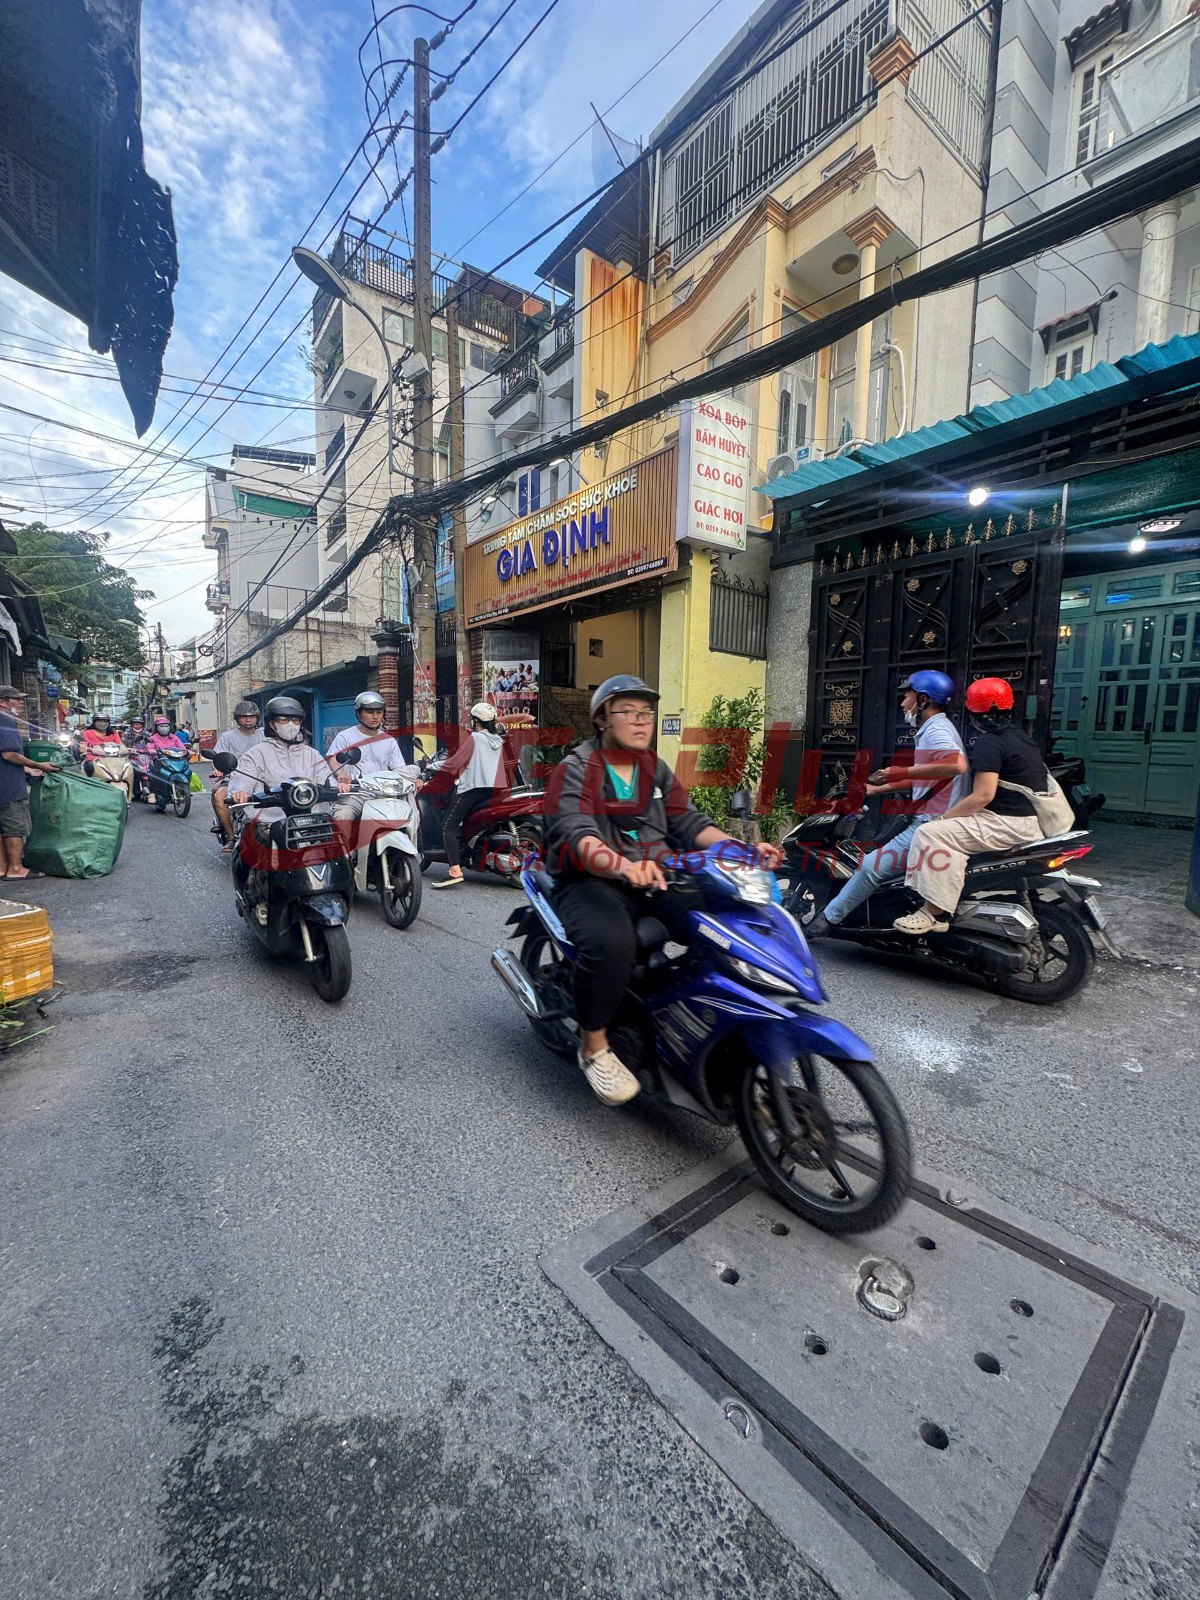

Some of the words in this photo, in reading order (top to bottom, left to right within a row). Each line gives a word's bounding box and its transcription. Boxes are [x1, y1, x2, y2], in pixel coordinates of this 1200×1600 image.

[698, 401, 723, 422] XOA
[725, 412, 747, 430] BÓP
[695, 428, 717, 448] BẤM
[719, 437, 746, 459] HUYỆT
[696, 462, 721, 481] CẠO
[723, 470, 743, 489] GIÓ
[482, 536, 506, 555] TRUNG
[508, 528, 525, 544] TÂM
[527, 512, 555, 535] CHĂM
[556, 500, 578, 522] SÓC
[580, 489, 602, 512] SỨC
[694, 499, 721, 518] GIÁC
[724, 507, 744, 525] HƠI
[496, 541, 538, 582] GIA
[542, 505, 610, 567] ĐỊNH
